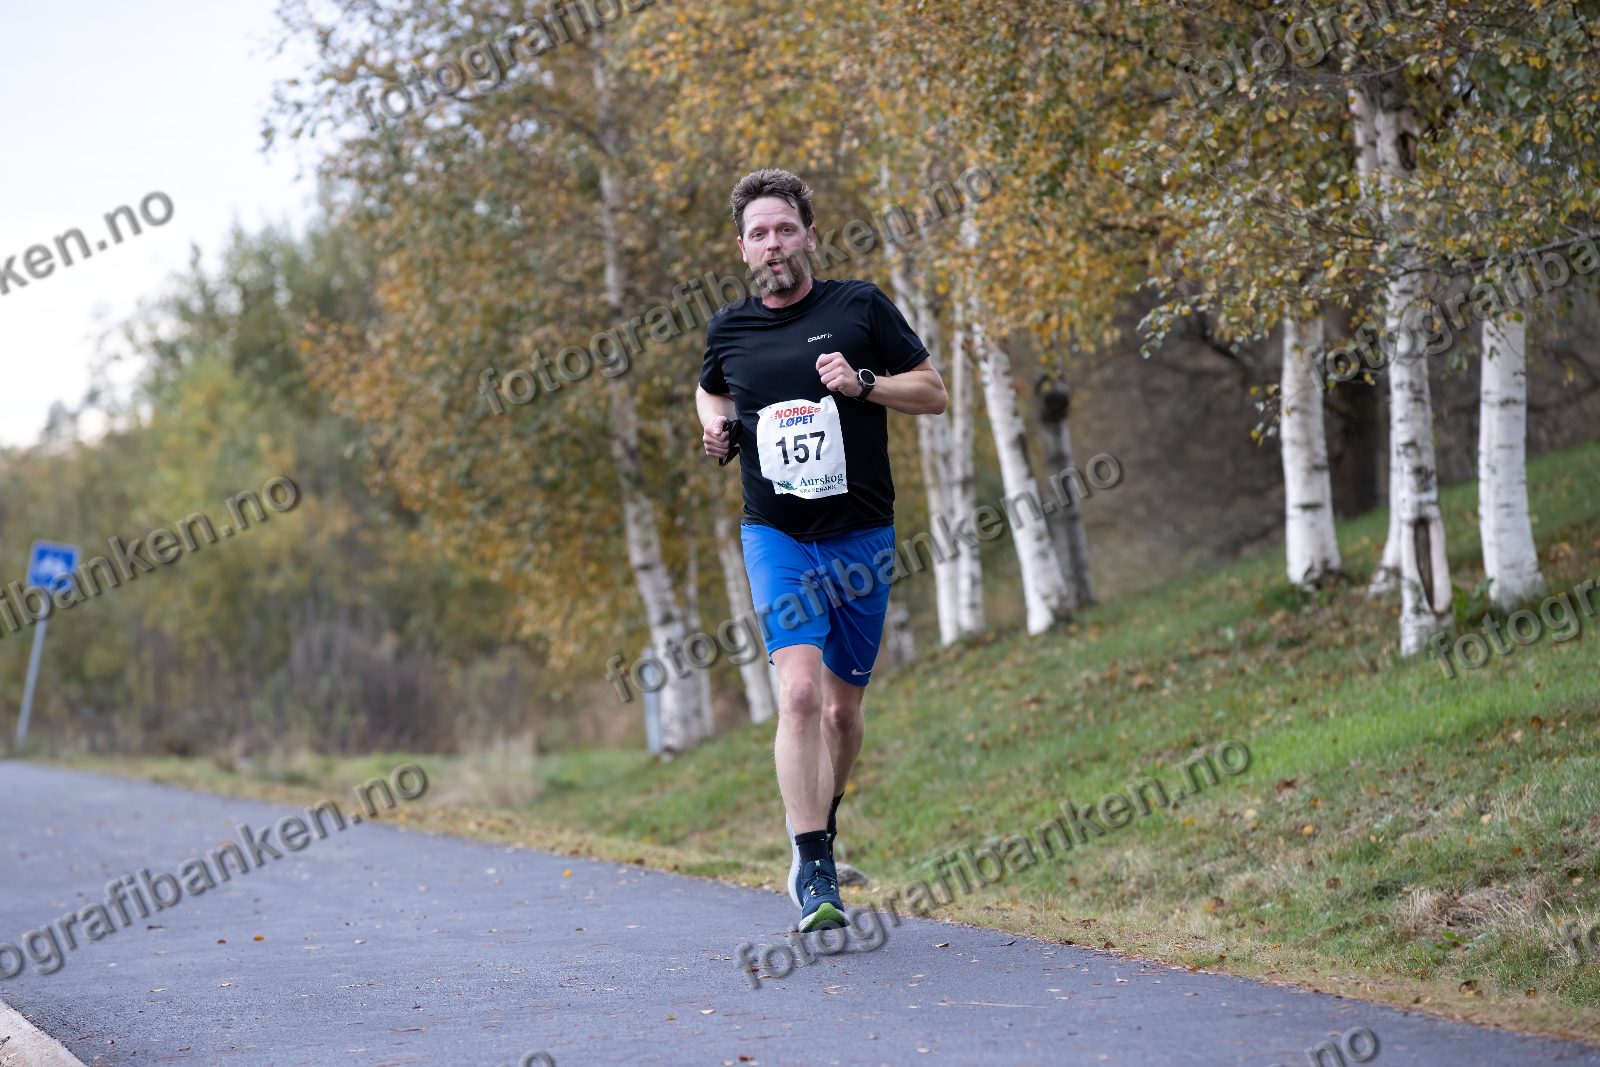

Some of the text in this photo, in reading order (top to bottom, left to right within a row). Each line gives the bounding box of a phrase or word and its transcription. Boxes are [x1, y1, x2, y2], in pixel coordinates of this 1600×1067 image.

[779, 414, 814, 428] LØPET
[776, 431, 825, 465] 157
[799, 473, 844, 487] Aurskog
